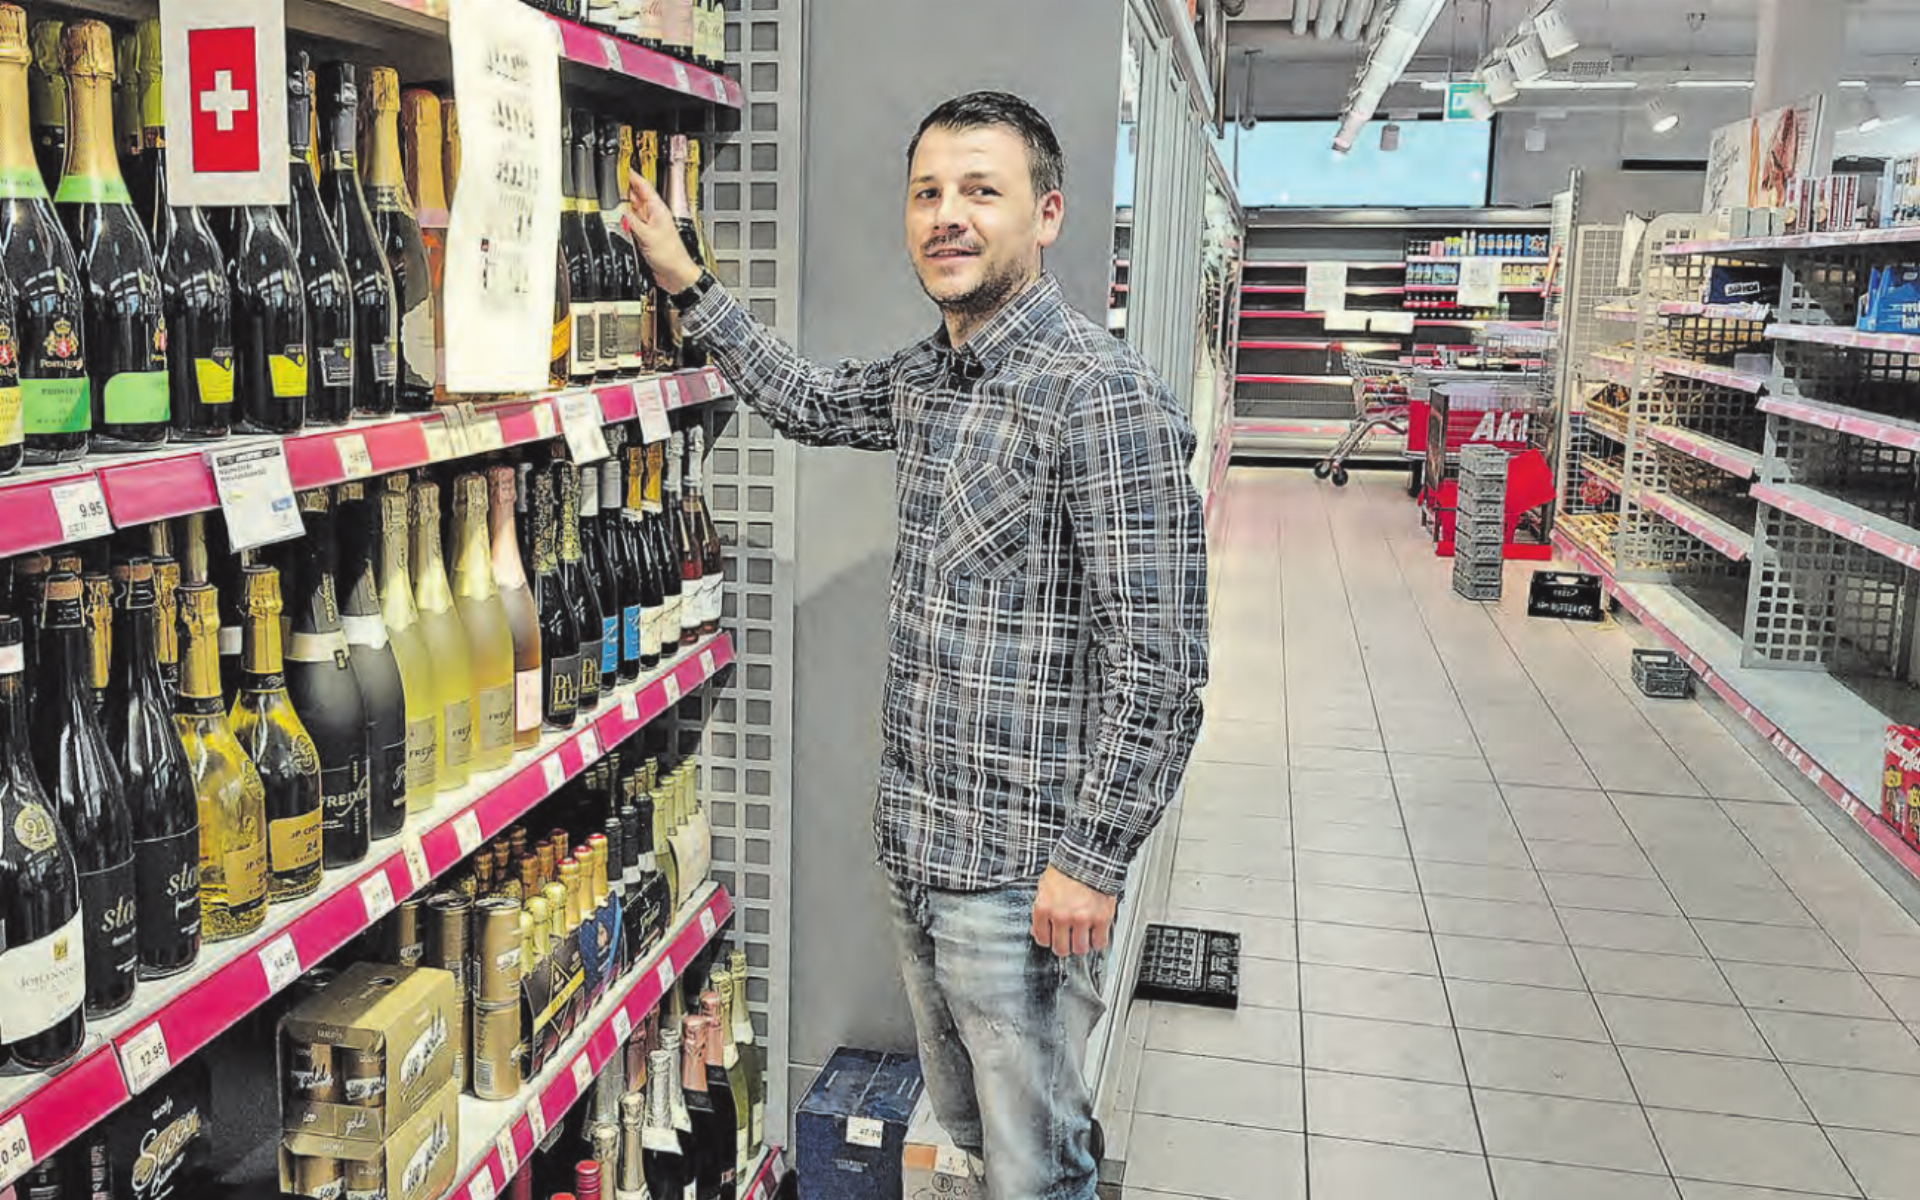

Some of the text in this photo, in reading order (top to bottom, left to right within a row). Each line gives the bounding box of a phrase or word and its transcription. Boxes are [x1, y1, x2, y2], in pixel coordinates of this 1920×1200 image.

[79, 500, 104, 518] 9.95
[140, 1042, 165, 1067] 12.95
[0, 1138, 27, 1168] 0.50
